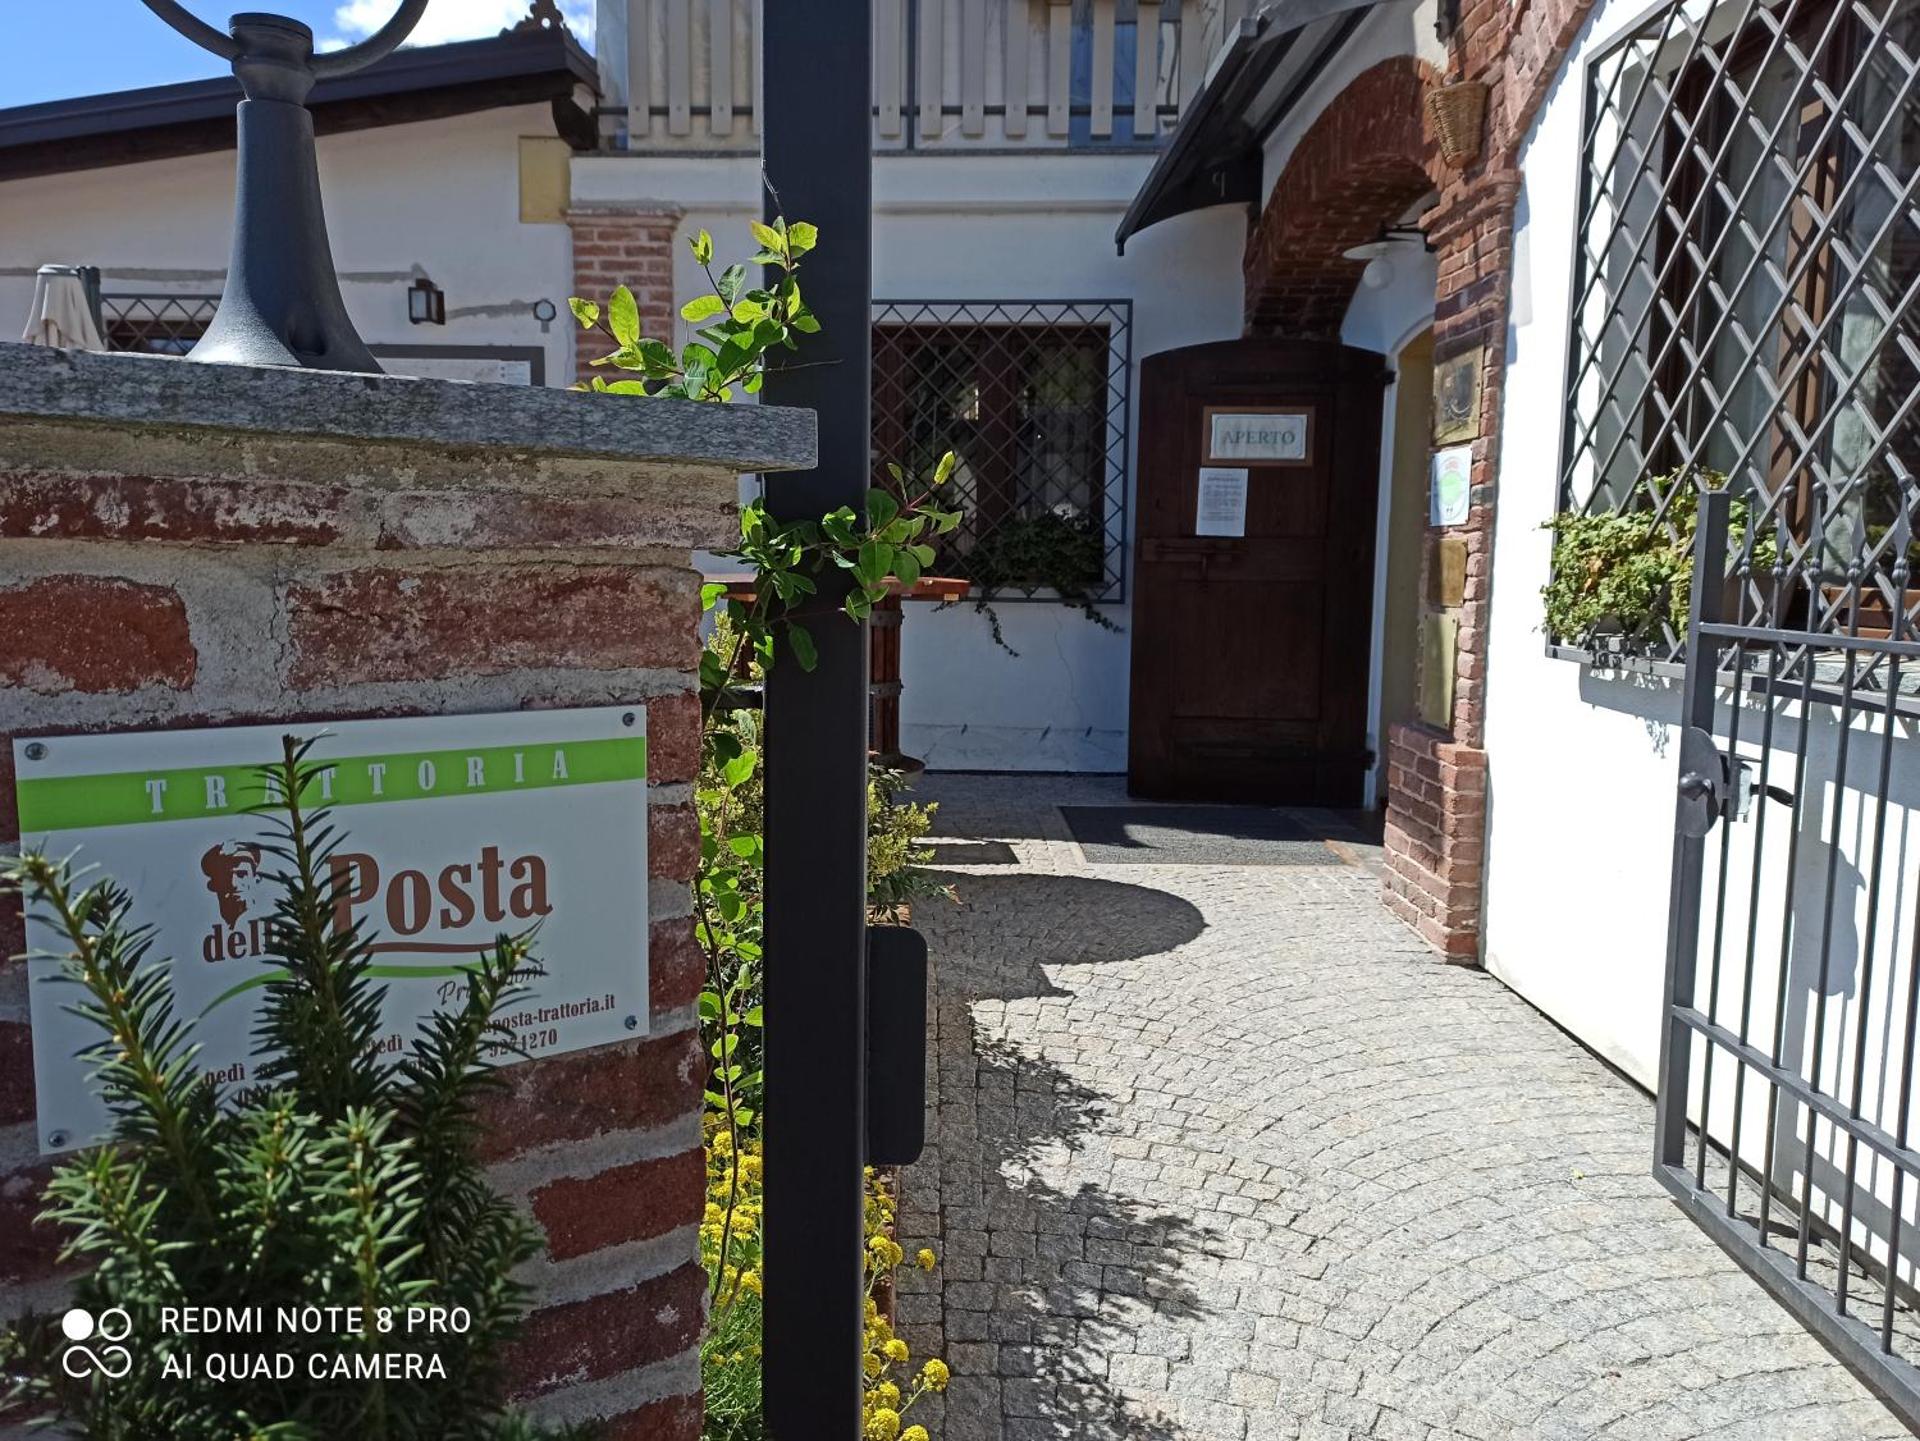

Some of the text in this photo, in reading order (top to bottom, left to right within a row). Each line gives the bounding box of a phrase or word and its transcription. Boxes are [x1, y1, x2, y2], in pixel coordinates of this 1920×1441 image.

[1222, 430, 1296, 445] APERTO
[145, 749, 569, 814] TRATTORIA
[202, 846, 553, 963] dell Posta
[196, 1062, 246, 1086] nedì
